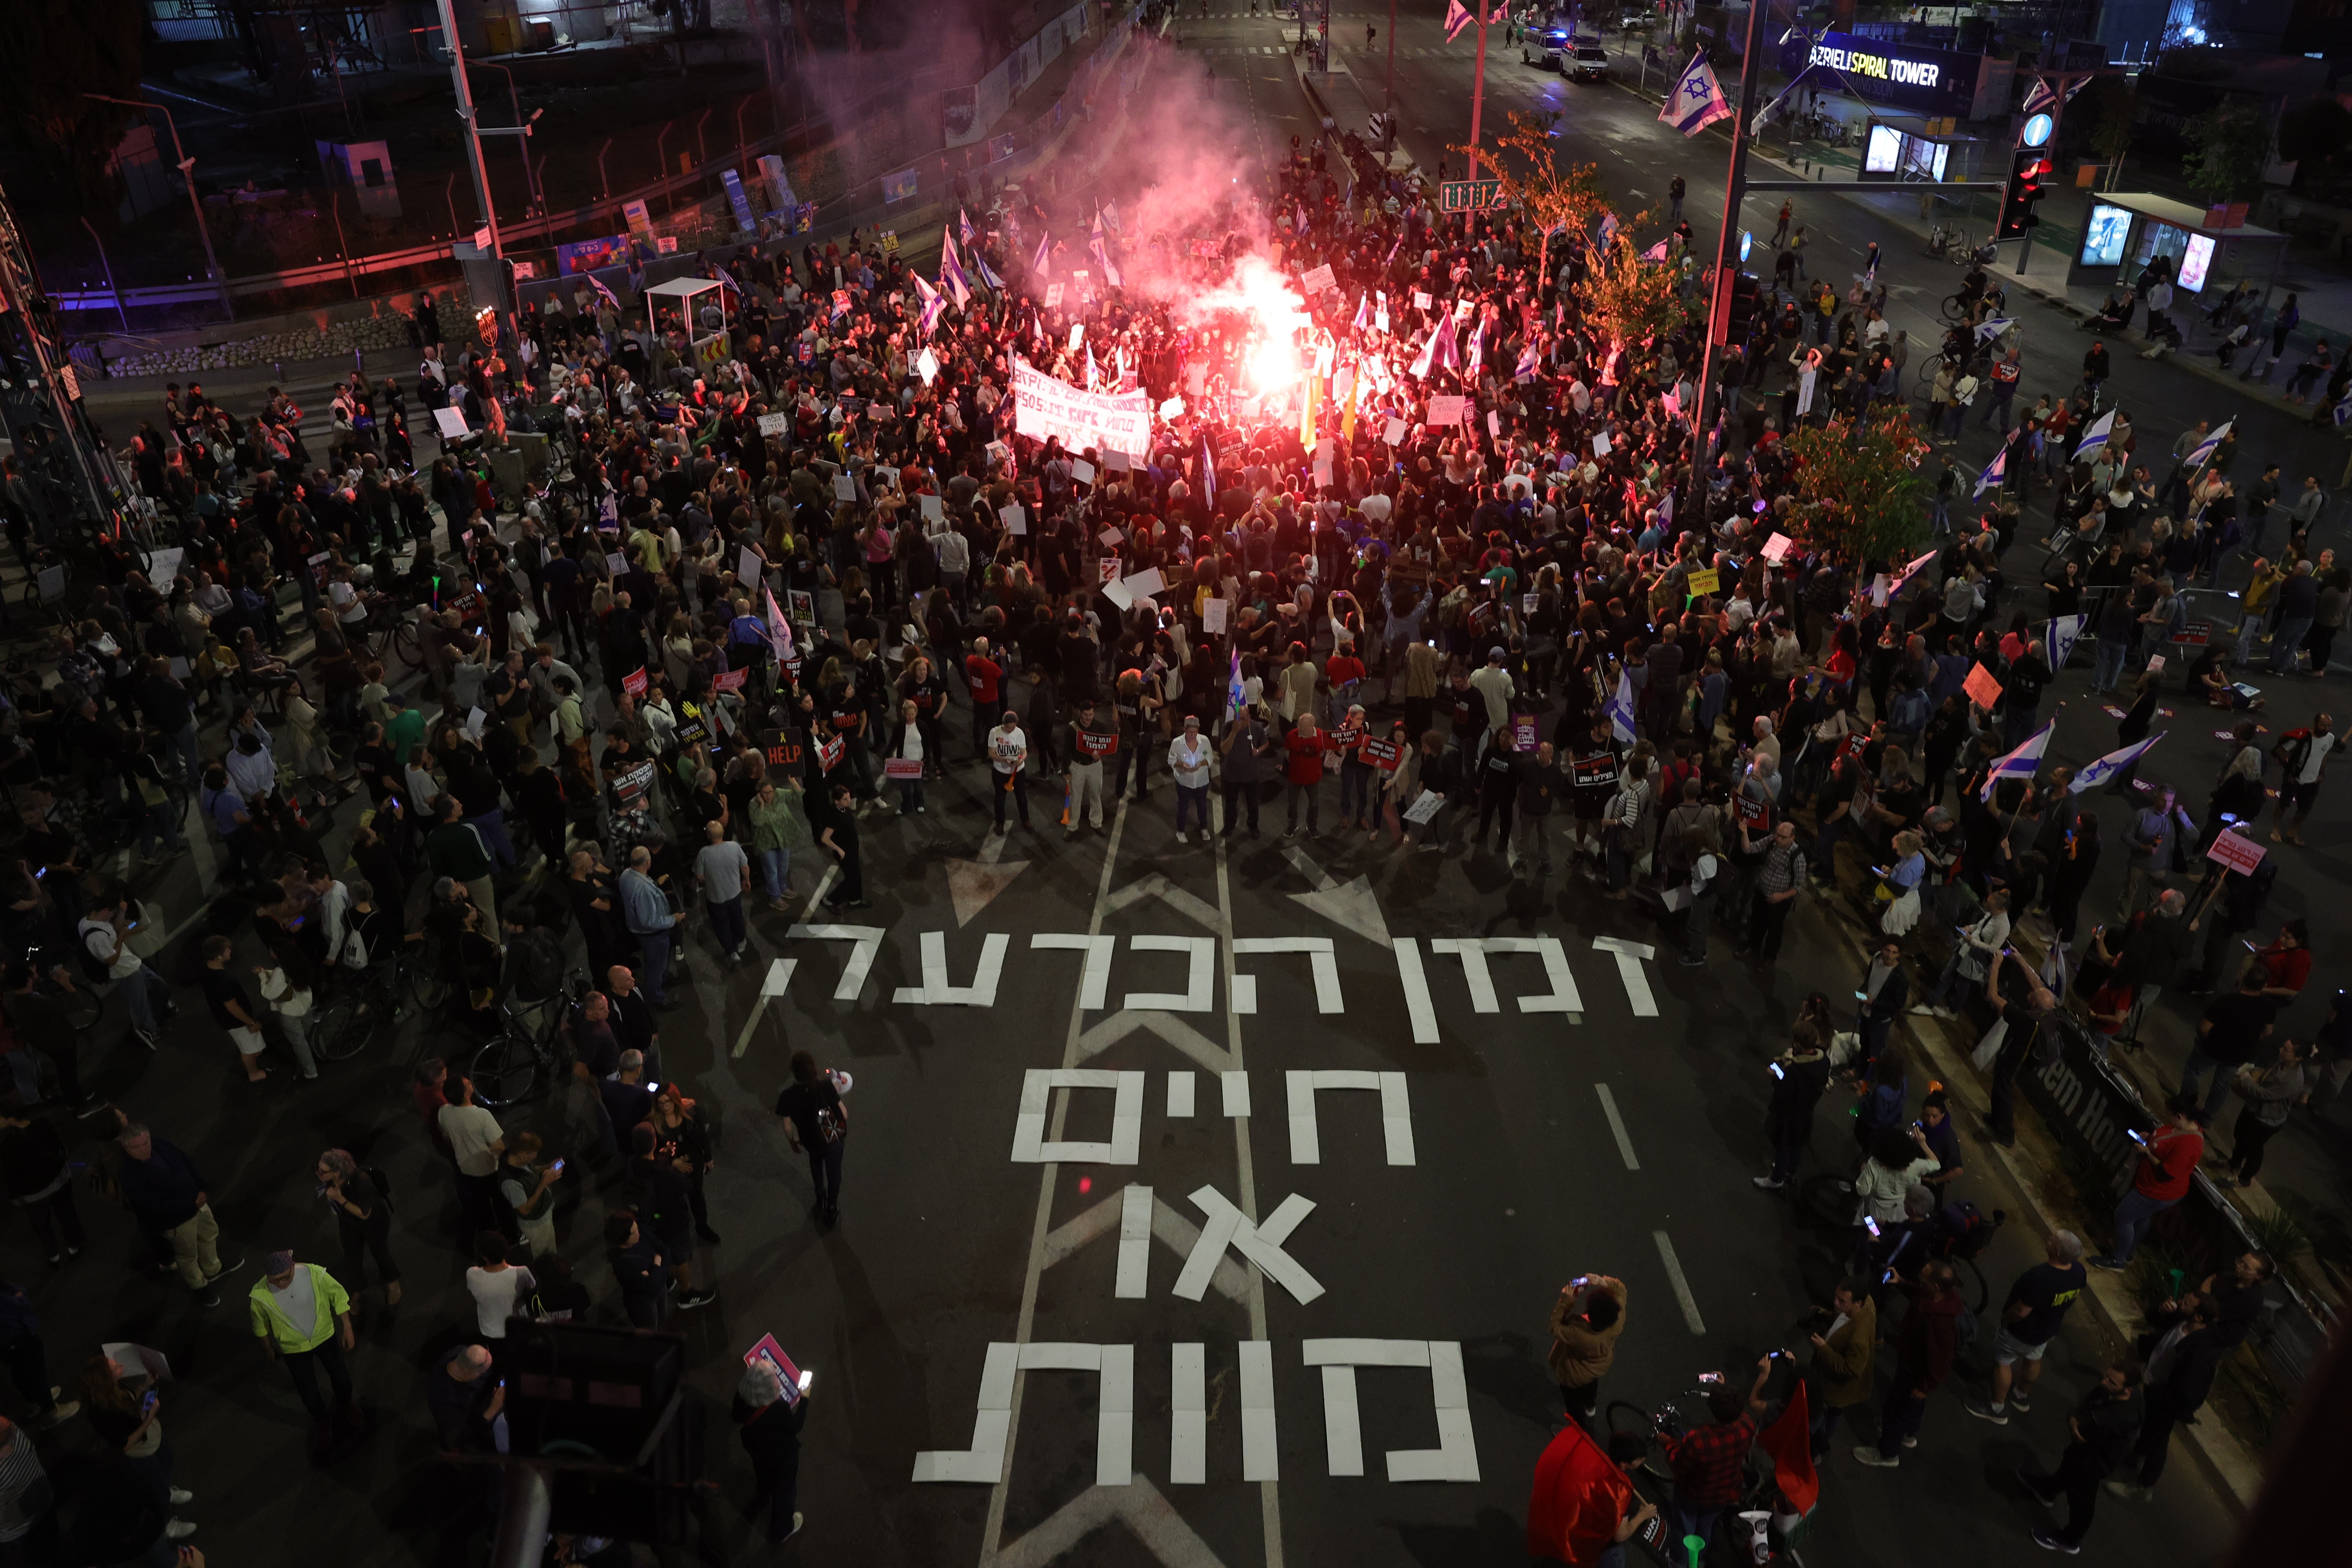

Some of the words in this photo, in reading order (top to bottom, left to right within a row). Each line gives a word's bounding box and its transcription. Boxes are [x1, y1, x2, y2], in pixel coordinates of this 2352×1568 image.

[1850, 52, 1888, 80] SPIRAL
[1891, 59, 1939, 88] TOWER
[1872, 79, 1894, 97] SOON
[1695, 581, 1713, 589] הביתה
[454, 593, 476, 607] ויתרתם
[680, 723, 700, 737] עסקה
[1331, 729, 1357, 738] ויתרתם
[997, 744, 1020, 755] NOW!
[1086, 741, 1107, 750] הזמן!
[1370, 740, 1384, 750] BRING
[1384, 744, 1396, 753] THEM
[768, 744, 802, 765] HELP
[1367, 747, 1380, 757] HOME
[1380, 752, 1396, 761] NOW!!!
[627, 762, 652, 784] הפסקת
[1593, 771, 1614, 782] מצילים
[613, 775, 627, 787] אש
[1737, 796, 1761, 812] ויתרתם
[2220, 836, 2236, 848] גורלי
[2239, 856, 2253, 867] חיים
[762, 923, 1344, 1014] הכרעה
[1392, 935, 1660, 1044] זמן
[1011, 1069, 1417, 1166] חיים
[1115, 1184, 1326, 1306] או
[911, 1338, 1481, 1486] מוות
